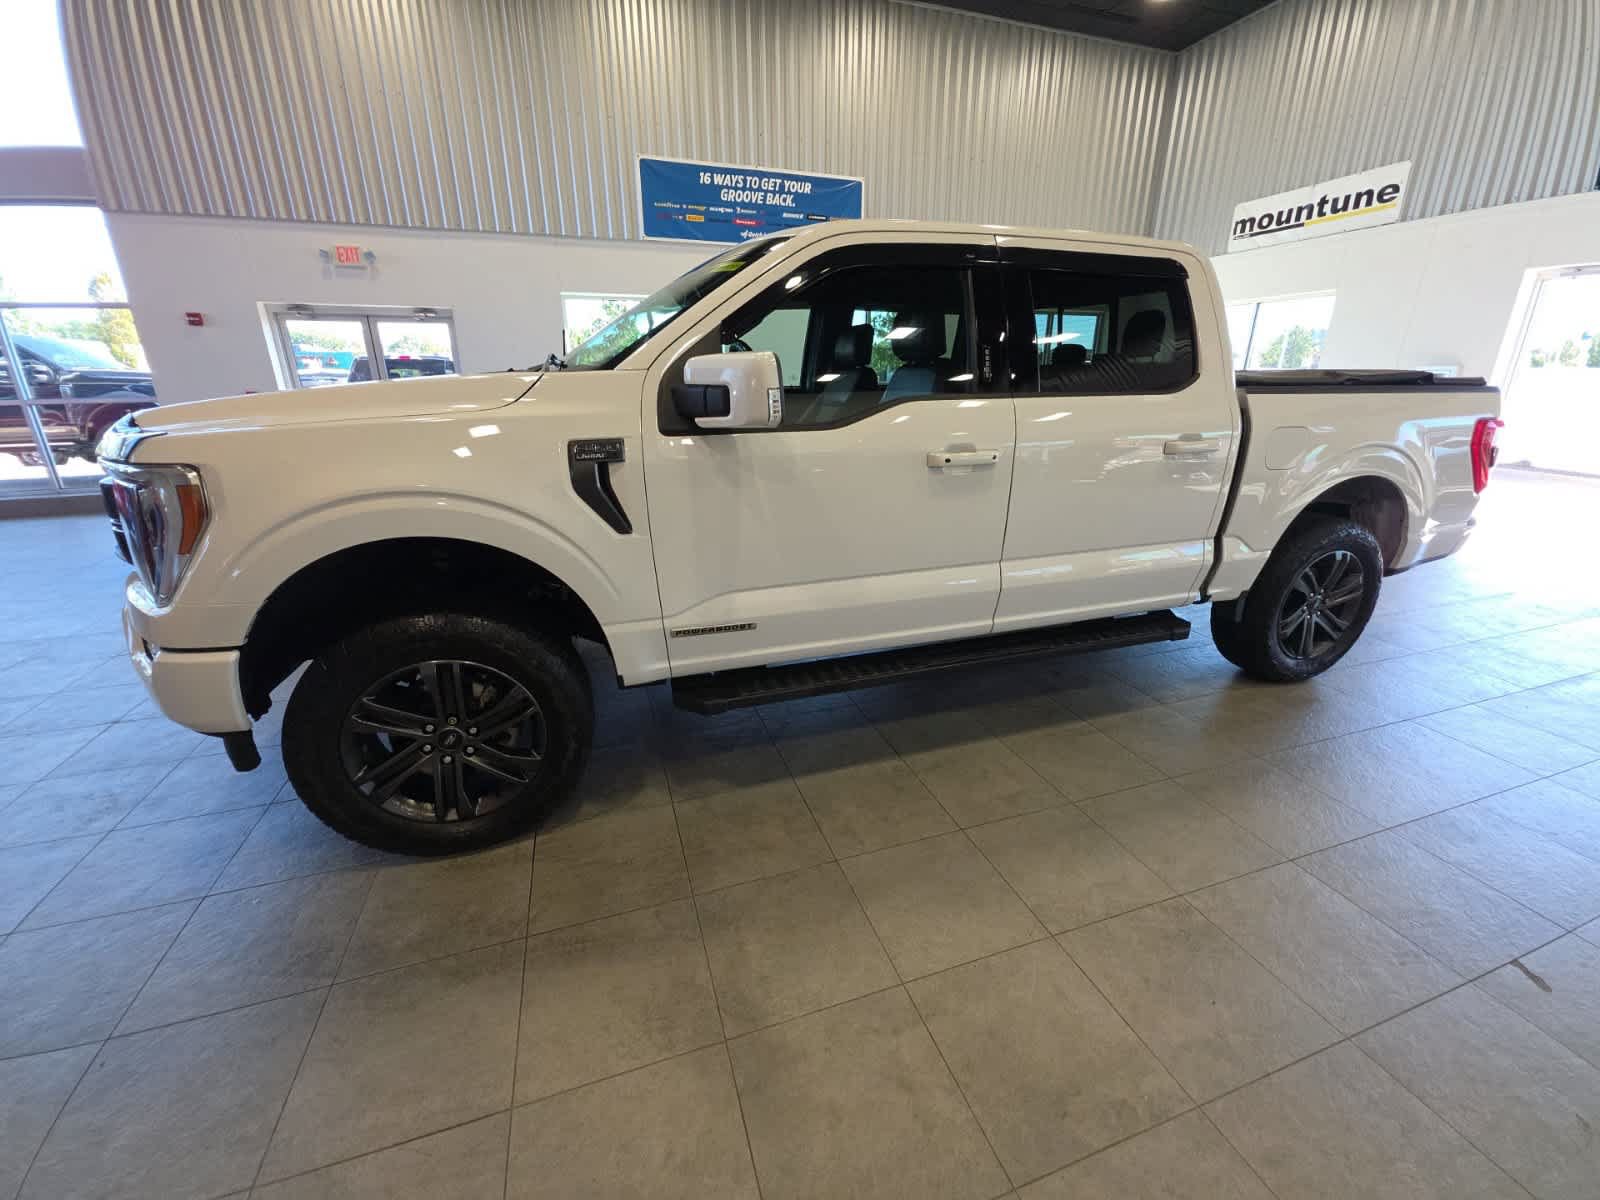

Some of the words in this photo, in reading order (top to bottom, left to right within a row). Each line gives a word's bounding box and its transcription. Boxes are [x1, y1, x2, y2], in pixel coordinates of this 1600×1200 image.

[699, 172, 711, 185] 16
[713, 173, 744, 188] WAYS
[745, 176, 759, 189] TO
[761, 178, 782, 191] GET
[784, 180, 812, 194] YOUR
[720, 188, 764, 205] GROOVE
[766, 193, 796, 207] BACK.
[1233, 183, 1400, 236] mountune
[336, 246, 360, 264] EXIT
